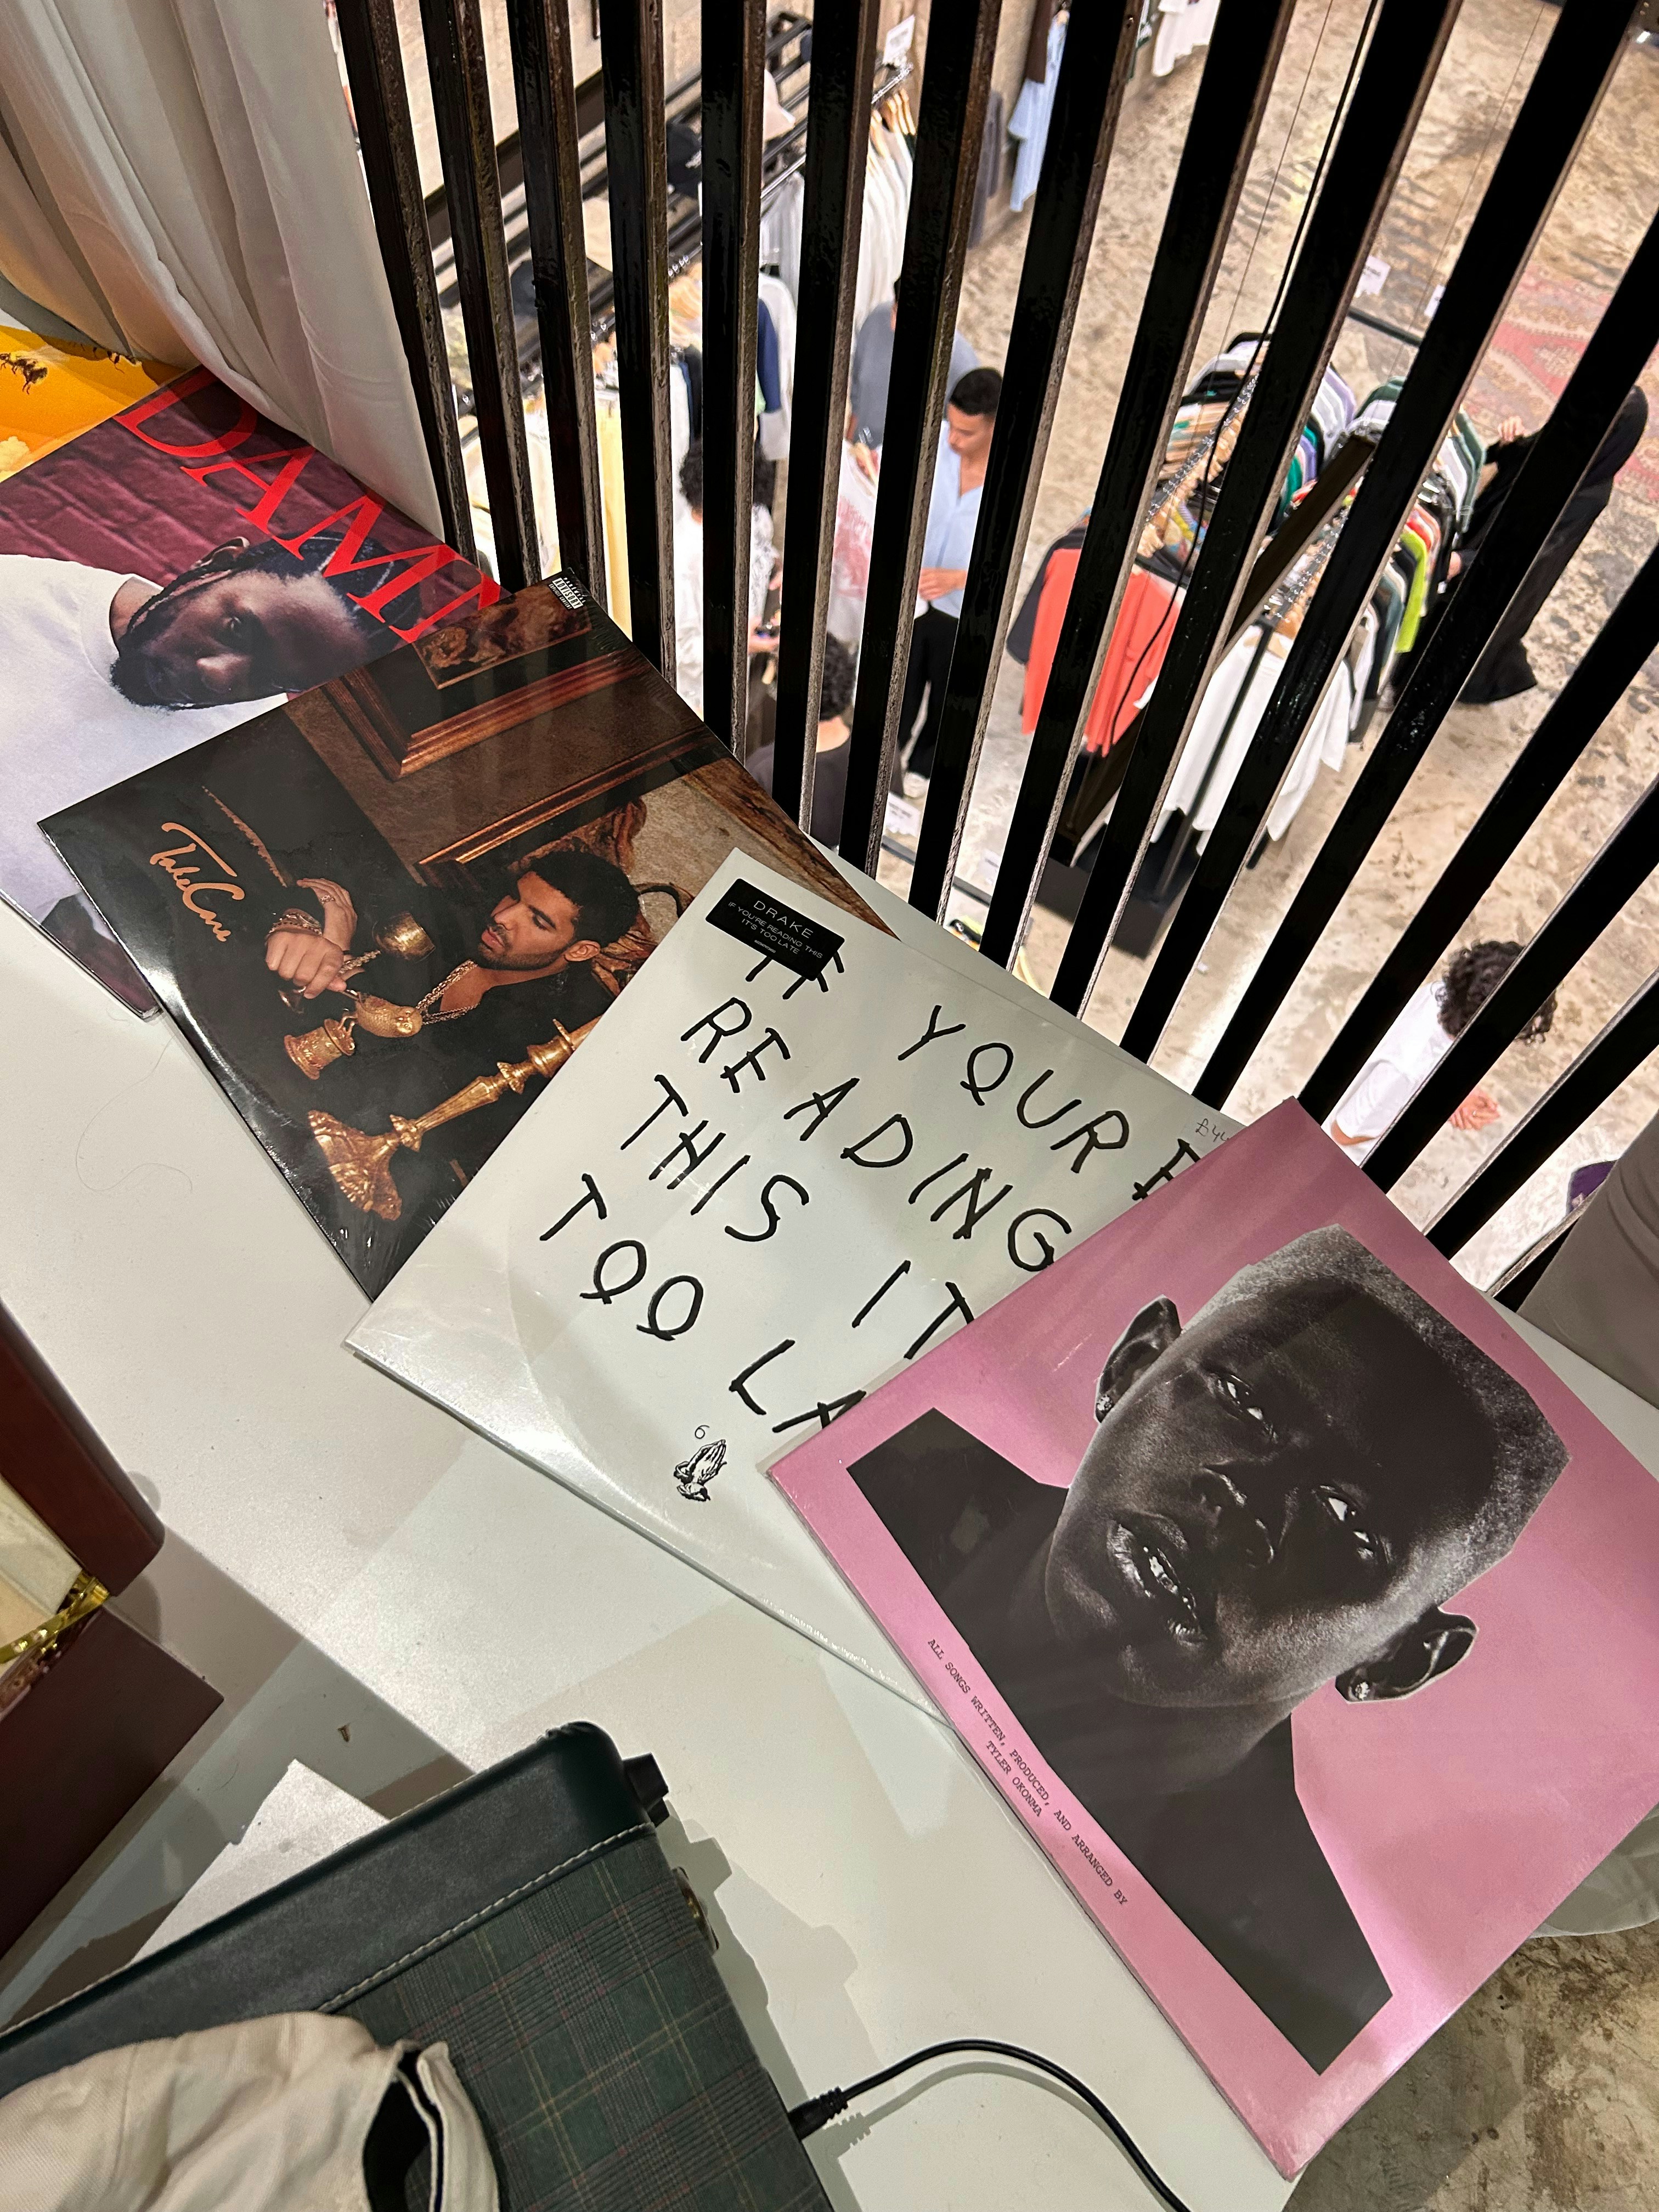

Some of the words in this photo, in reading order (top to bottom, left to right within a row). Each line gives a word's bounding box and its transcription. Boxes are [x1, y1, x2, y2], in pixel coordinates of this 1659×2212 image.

[554, 579, 582, 607] ADVISORY
[738, 906, 767, 927] YOU'RE
[767, 924, 803, 947] READING
[805, 945, 823, 958] THIS
[741, 918, 757, 930] IT'S
[760, 928, 777, 941] TOO
[778, 940, 800, 955] LATE
[753, 900, 814, 939] DRAKE
[621, 1075, 809, 1242] THIS
[681, 997, 1072, 1272] READING
[540, 1173, 703, 1341] TOO
[695, 1425, 710, 1440] 6
[928, 1639, 944, 1660] ALL
[945, 1662, 971, 1694] SONGS
[970, 1696, 1006, 1746] WRITTEN,
[1009, 1748, 1050, 1805] PRODUCED,
[1054, 1809, 1072, 1831] AND
[1071, 1833, 1113, 1887] ARRANGED
[1114, 1888, 1128, 1905] BY
[986, 1740, 1012, 1775] TYLER
[1012, 1776, 1042, 1818] OKONMA
